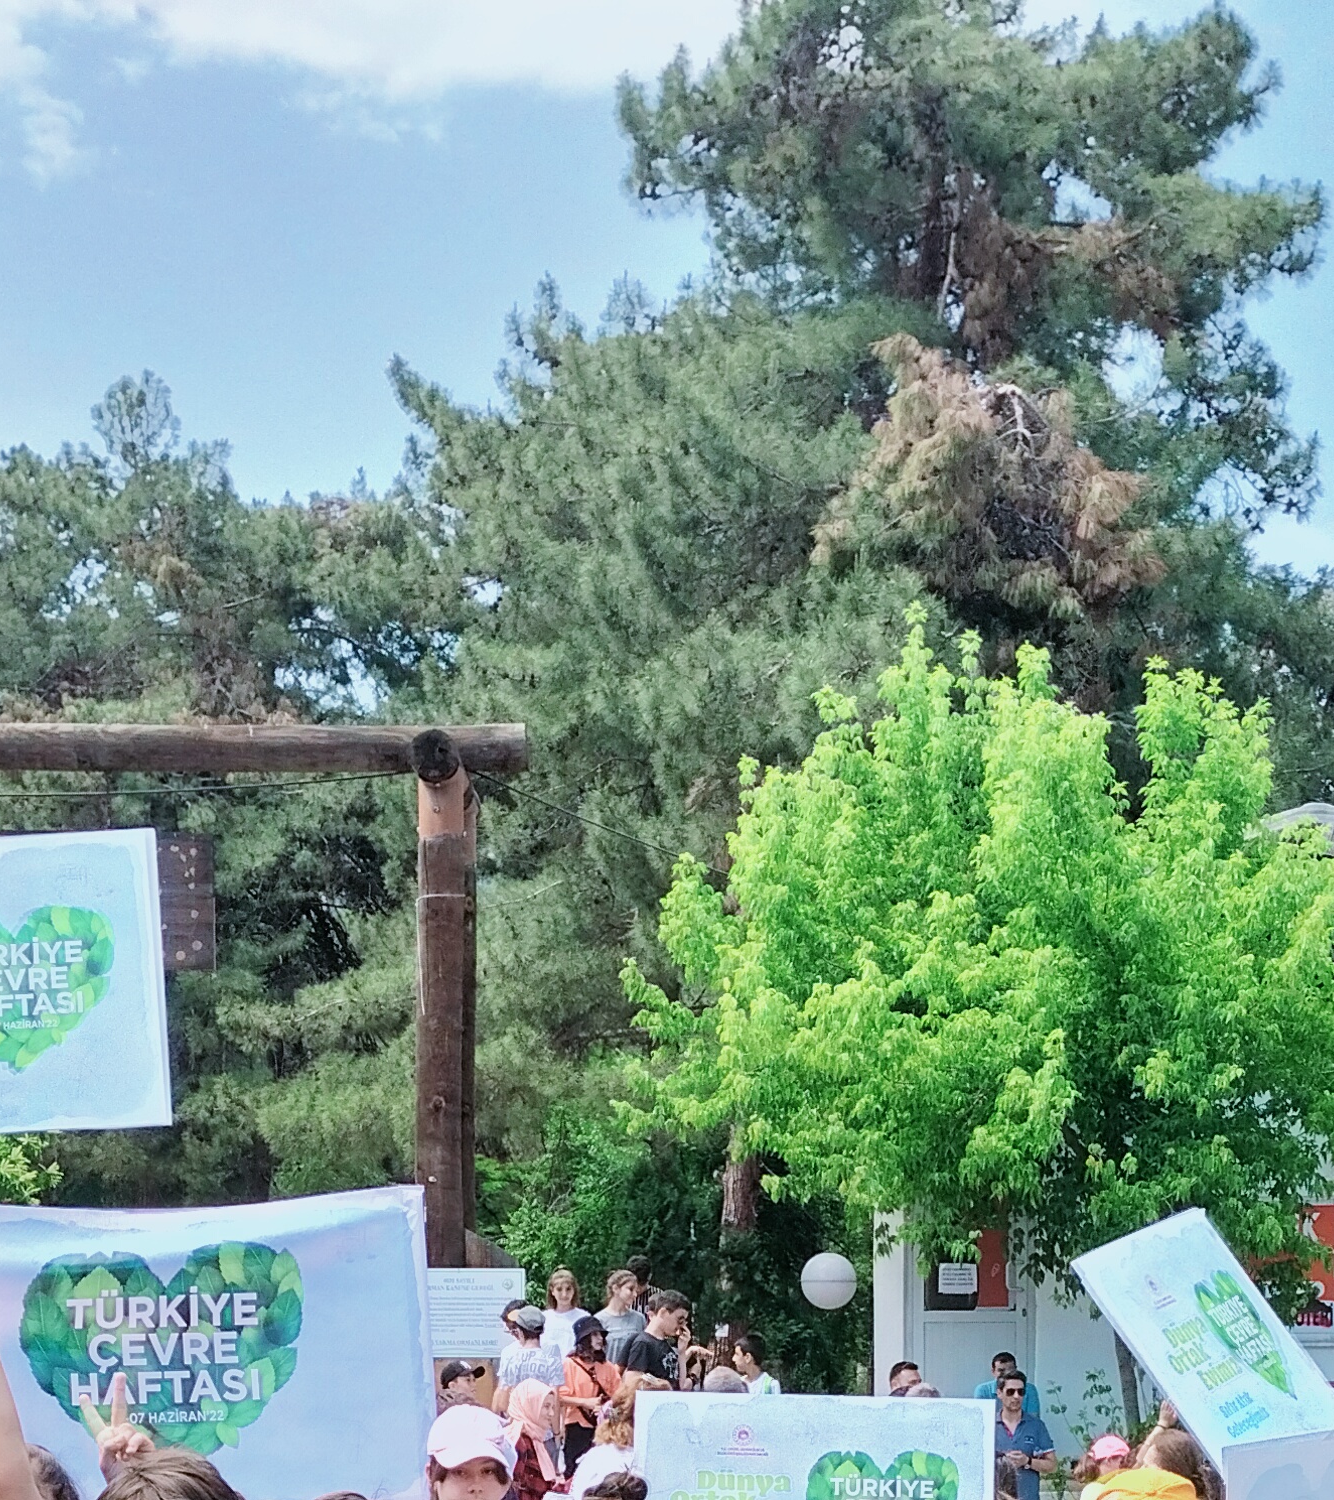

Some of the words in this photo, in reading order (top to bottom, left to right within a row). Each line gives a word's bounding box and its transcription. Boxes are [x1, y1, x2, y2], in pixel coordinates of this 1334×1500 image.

[67, 1285, 259, 1330] TÜRKİYE
[1207, 1294, 1248, 1327] TÜRKİYE
[1162, 1316, 1208, 1348] Dünya
[1226, 1316, 1259, 1344] ÇEVRE
[89, 1331, 239, 1374] ÇEVRE
[1168, 1341, 1211, 1375] Ortak
[149, 1409, 224, 1424] HAZİRAN'22
[697, 1470, 791, 1497] Dünya
[830, 1473, 934, 1499] TÜRKİYE
